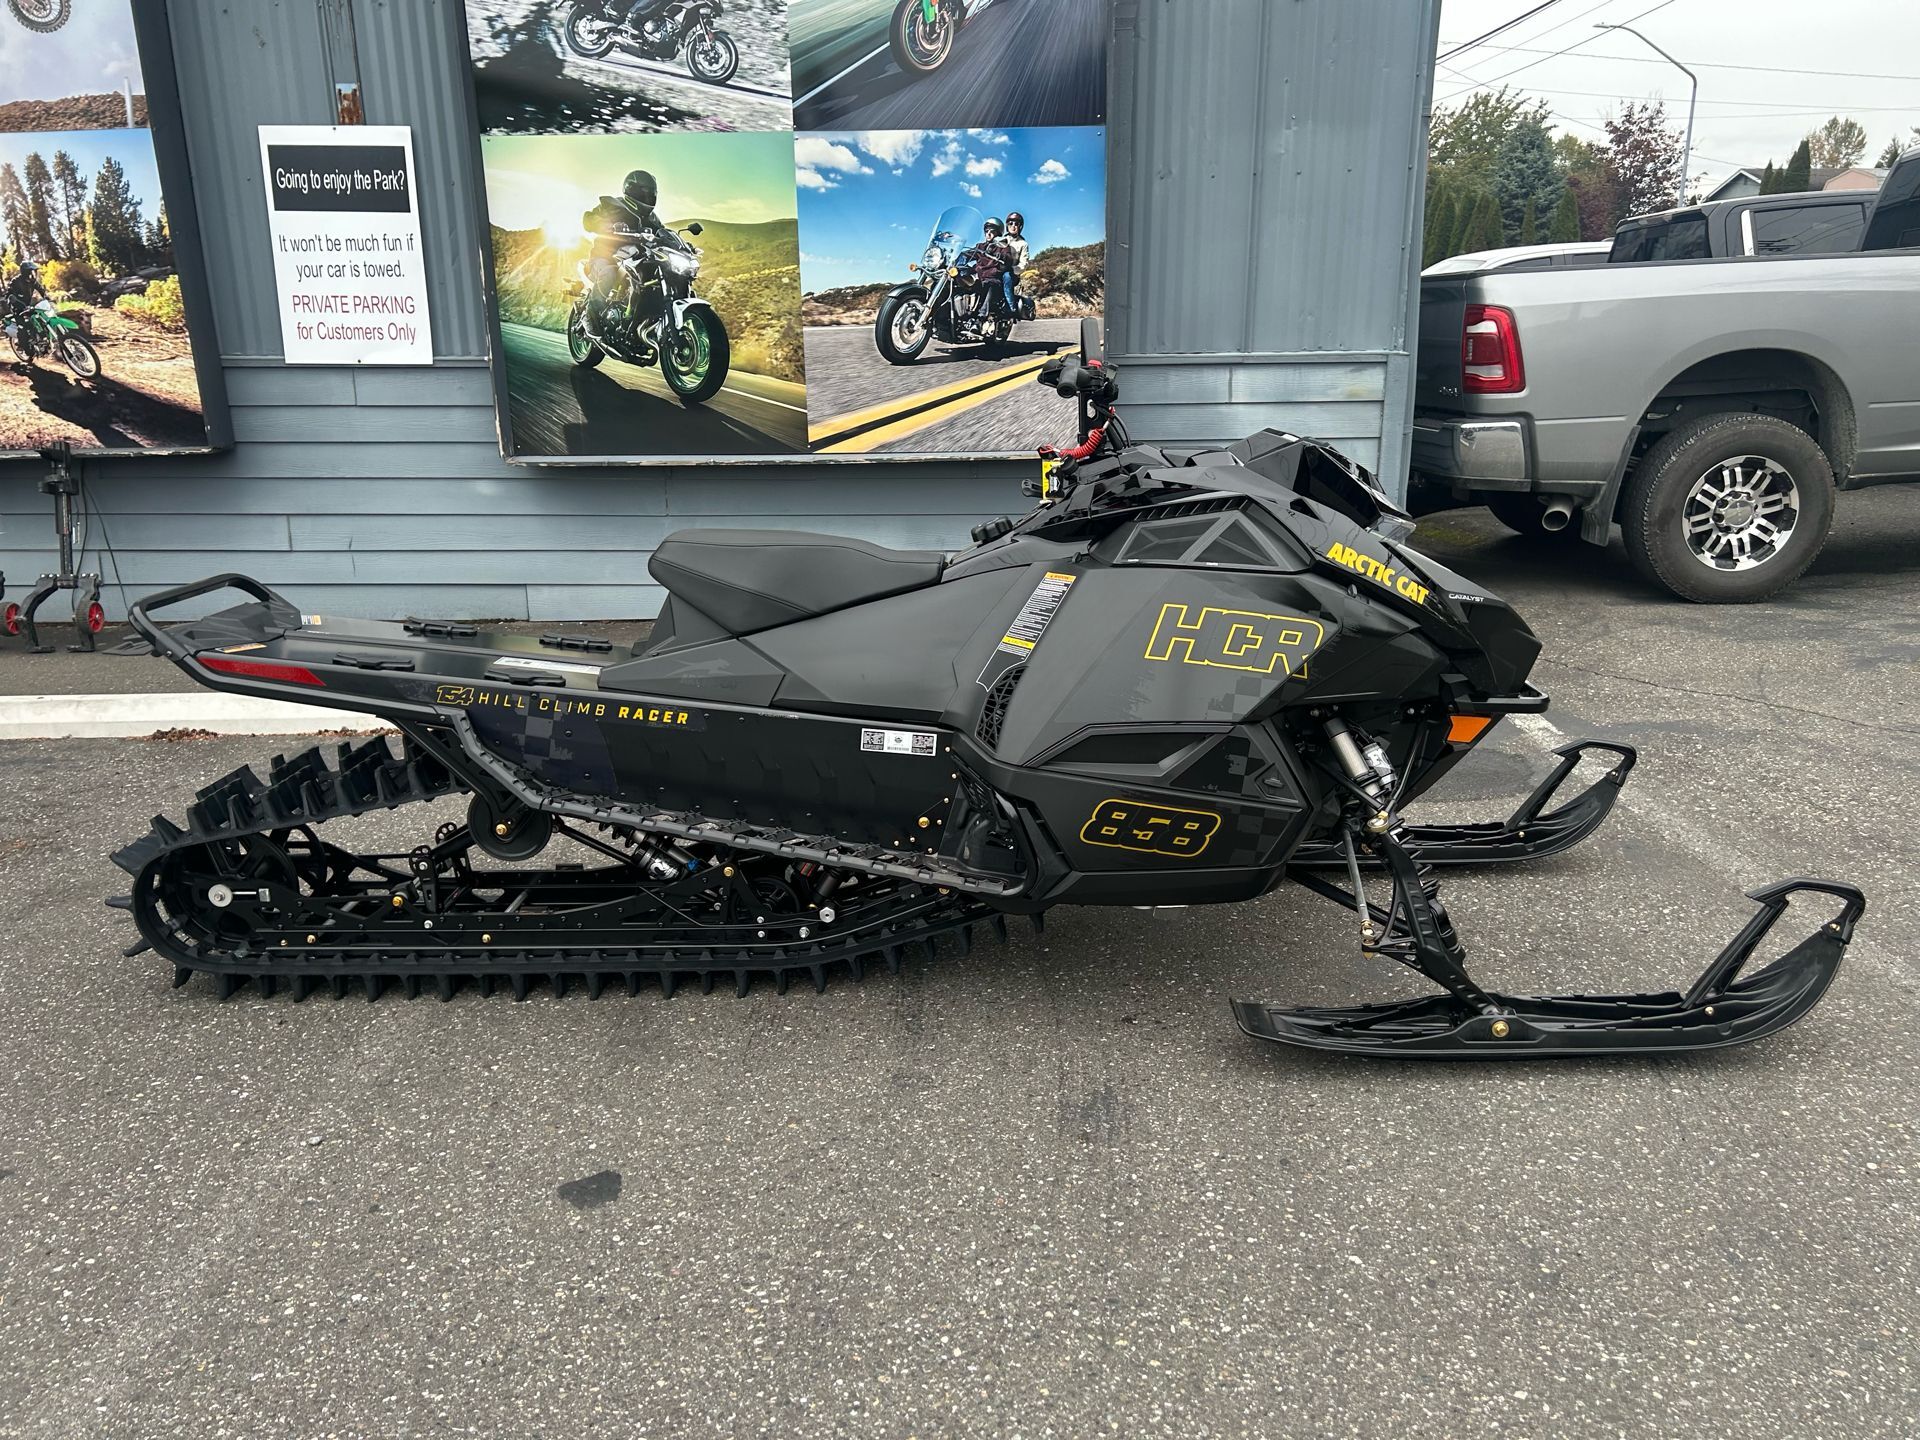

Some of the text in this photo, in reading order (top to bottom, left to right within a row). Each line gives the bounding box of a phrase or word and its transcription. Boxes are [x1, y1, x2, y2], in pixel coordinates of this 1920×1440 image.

[276, 167, 405, 195] Going to enjoy the Park?
[278, 233, 414, 252] It won't be much fun if
[296, 260, 405, 282] your car is towed.
[292, 295, 416, 315] PRIVATE PARKING
[297, 321, 416, 345] for Customers Only
[1326, 541, 1430, 605] ARCTIC CAT
[1448, 593, 1485, 603] CATALYST
[1144, 603, 1324, 679] HCR
[437, 685, 689, 725] 154 HILL CLIMB RACER
[1079, 798, 1222, 858] 858
